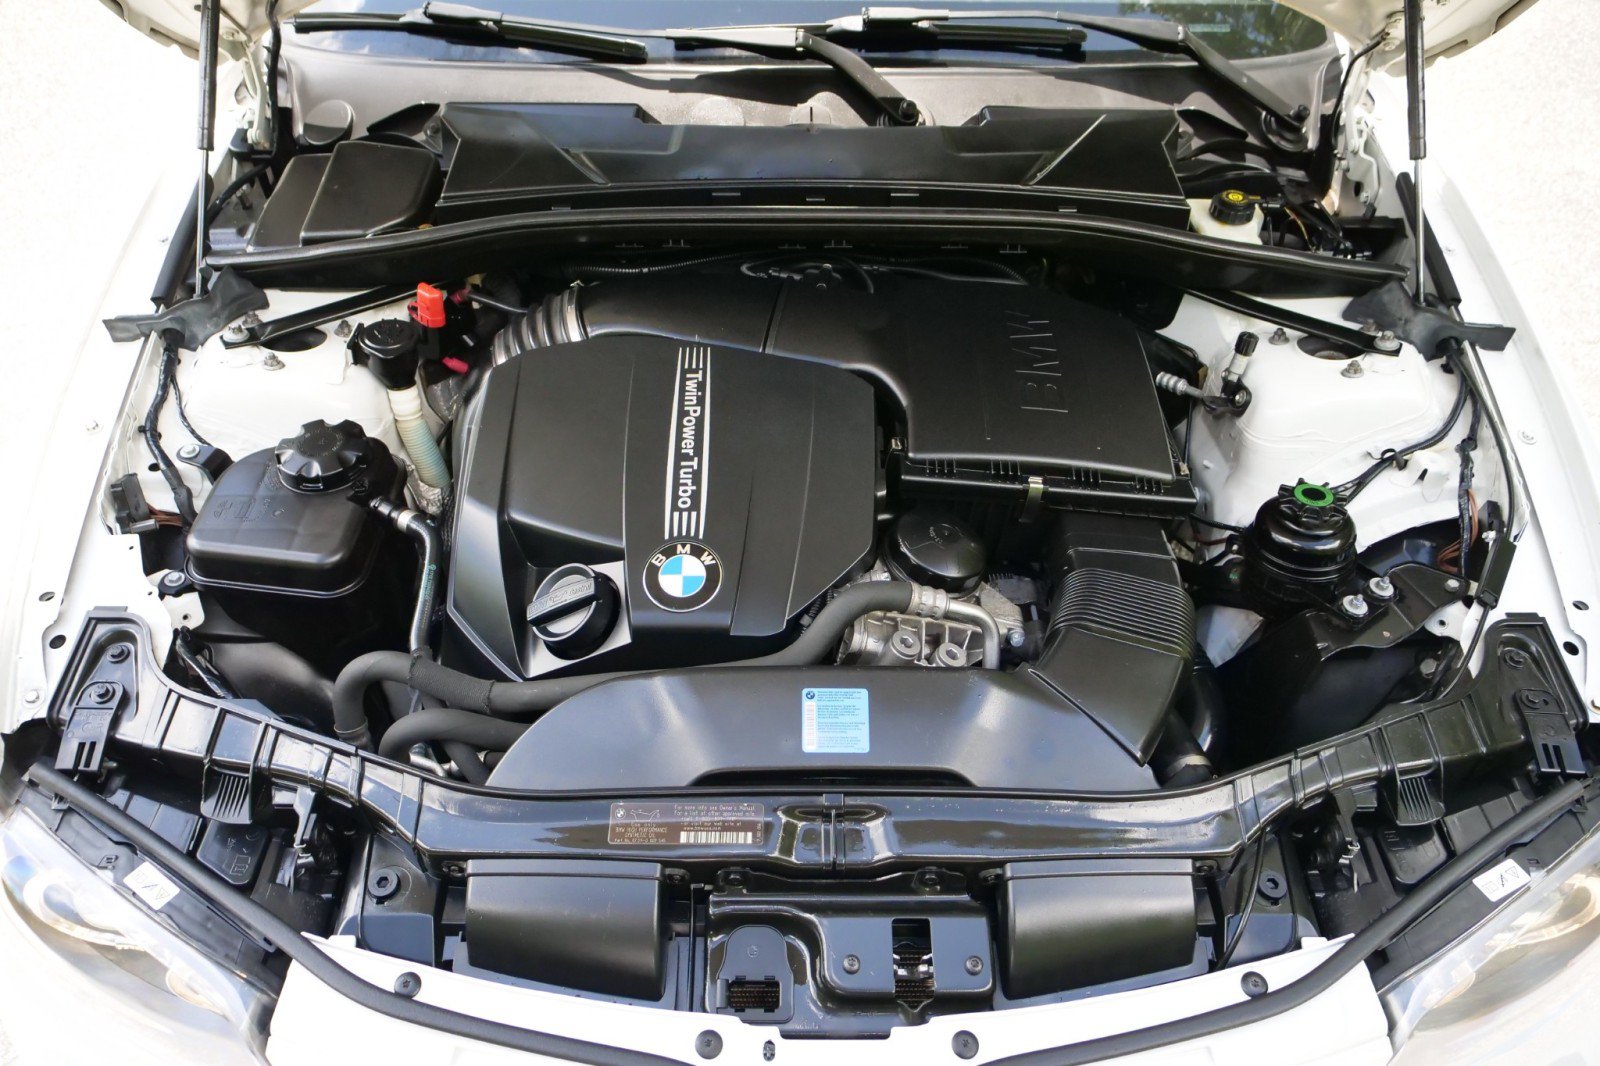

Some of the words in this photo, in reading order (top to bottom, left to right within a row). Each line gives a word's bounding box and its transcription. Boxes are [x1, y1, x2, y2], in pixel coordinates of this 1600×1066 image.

[682, 370, 702, 456] TwinPower
[678, 457, 698, 508] Turbo
[651, 543, 716, 567] BMW
